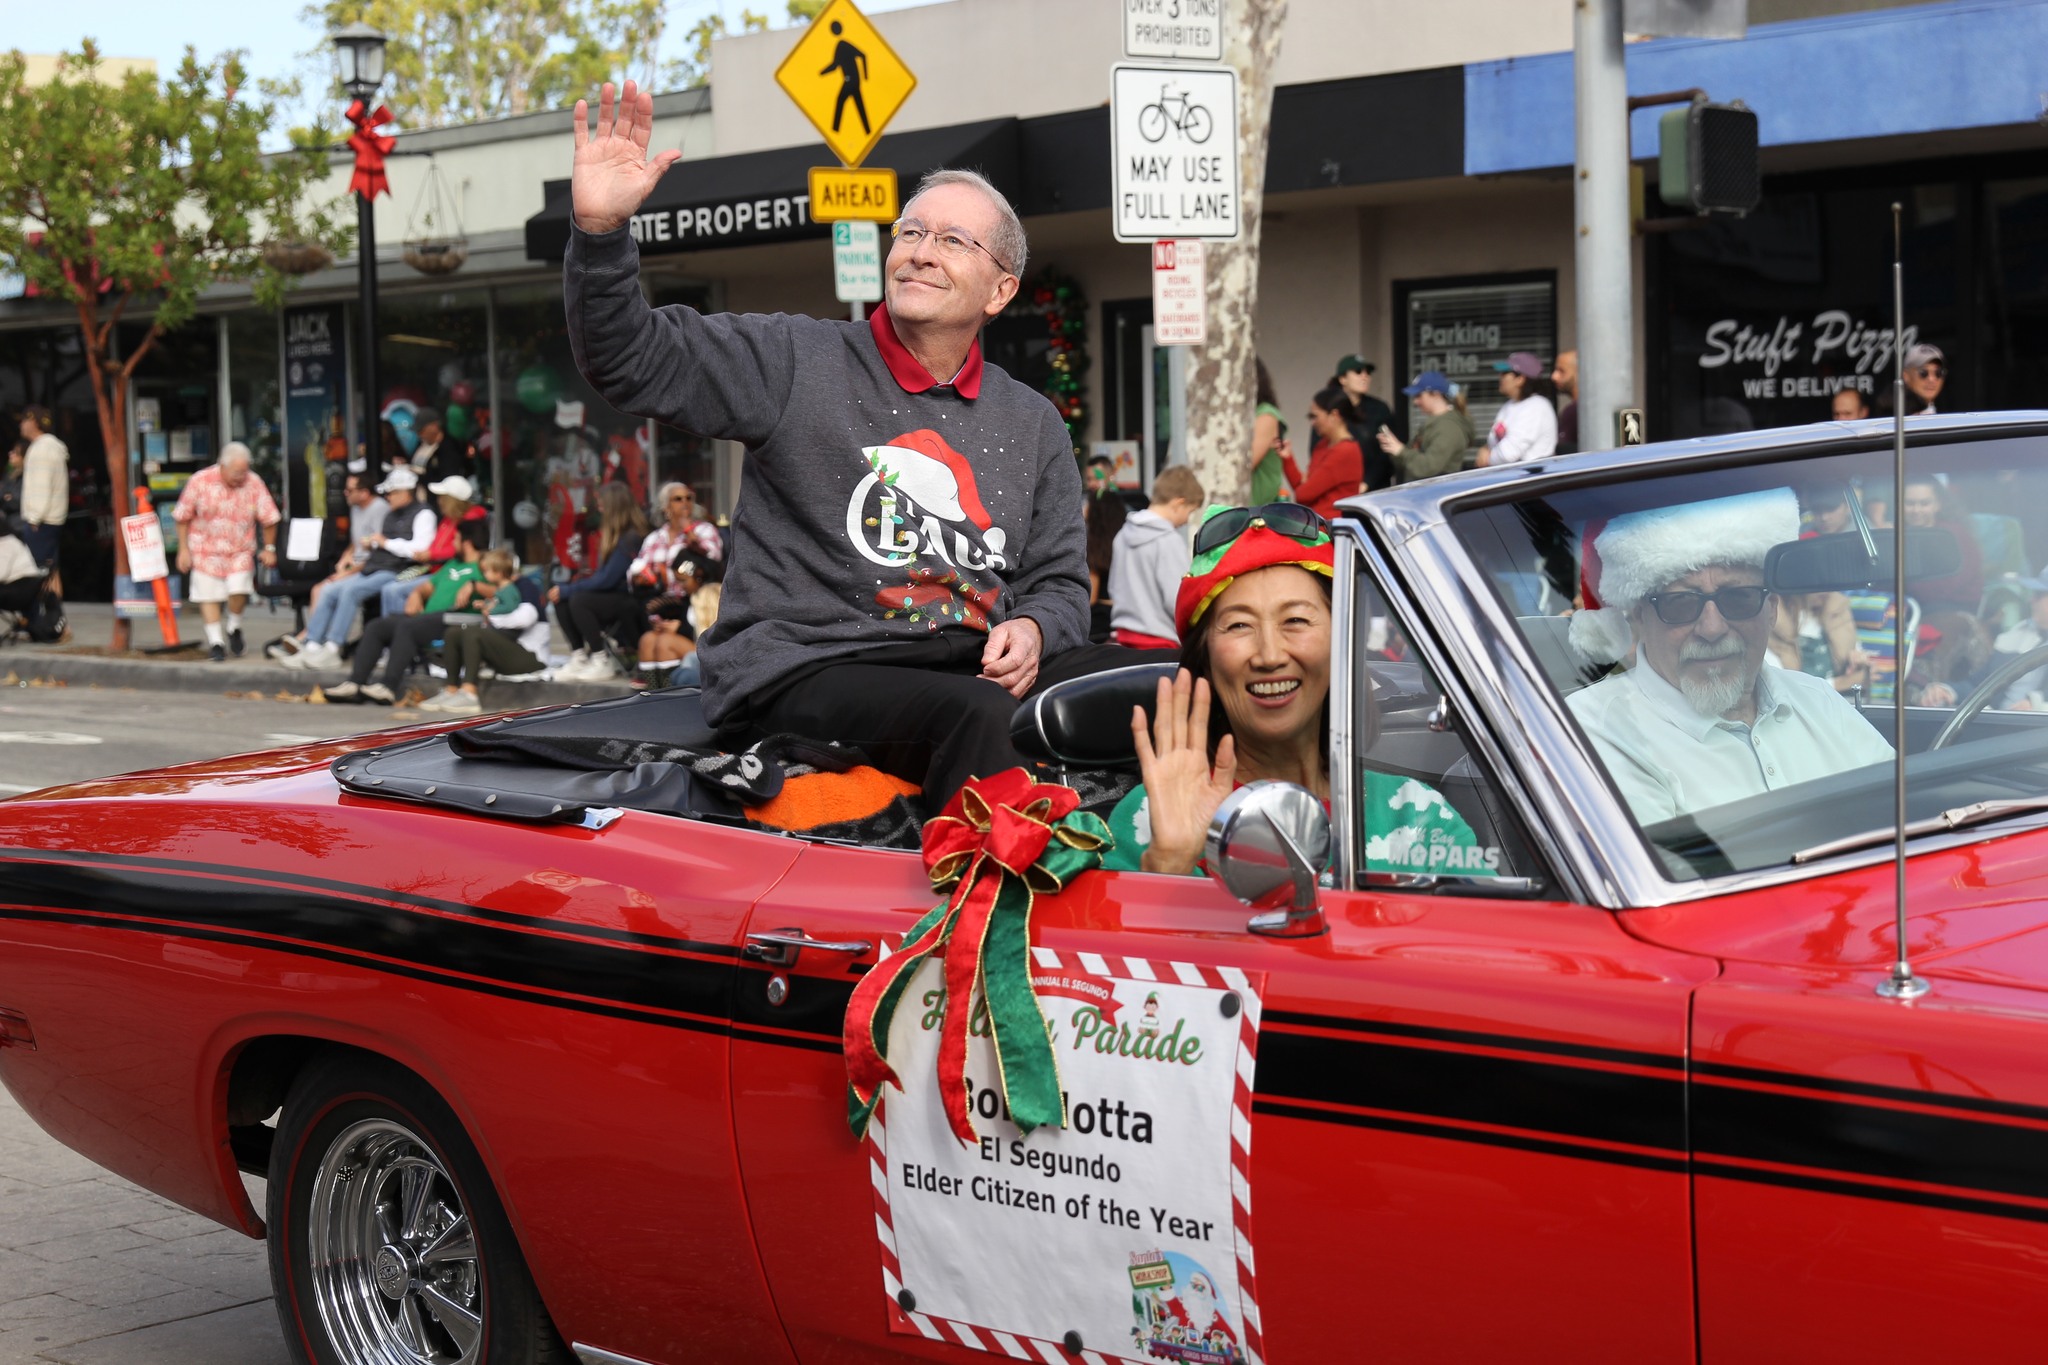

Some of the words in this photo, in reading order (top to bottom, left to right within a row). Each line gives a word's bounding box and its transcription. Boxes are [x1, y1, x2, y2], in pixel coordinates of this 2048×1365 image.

[1128, 0, 1162, 14] OVER
[1168, 0, 1180, 19] 3
[1186, 0, 1217, 17] TONS
[1135, 23, 1212, 46] PROHIBITED
[1131, 156, 1172, 182] MAY
[1184, 157, 1222, 182] USE
[821, 183, 886, 208] AHEAD
[1124, 193, 1170, 219] FULL
[1181, 194, 1230, 219] LANE
[630, 211, 672, 244] ATE
[677, 195, 811, 239] PROPERT
[836, 224, 850, 244] 2
[837, 252, 877, 265] PARKING
[1155, 241, 1175, 268] NO
[1420, 321, 1500, 349] Parking
[1698, 315, 1803, 377] Stuft
[1811, 309, 1919, 374] Pizza
[1421, 351, 1440, 372] in
[1445, 350, 1479, 373] the
[1743, 378, 1777, 399] WE
[1782, 375, 1874, 397] DELIVER
[846, 471, 1007, 572] CLAU
[1062, 977, 1070, 988] EL
[1071, 979, 1109, 1000] SEGUNDO
[1071, 1006, 1204, 1066] Parade
[1059, 1090, 1153, 1144] otta
[981, 1136, 1000, 1162] El
[1010, 1140, 1121, 1183] Segundo
[903, 1163, 963, 1196] Elder
[971, 1176, 1055, 1214] Citizen
[1065, 1194, 1089, 1219] of
[1098, 1199, 1140, 1230] the
[1150, 1206, 1214, 1241] Year
